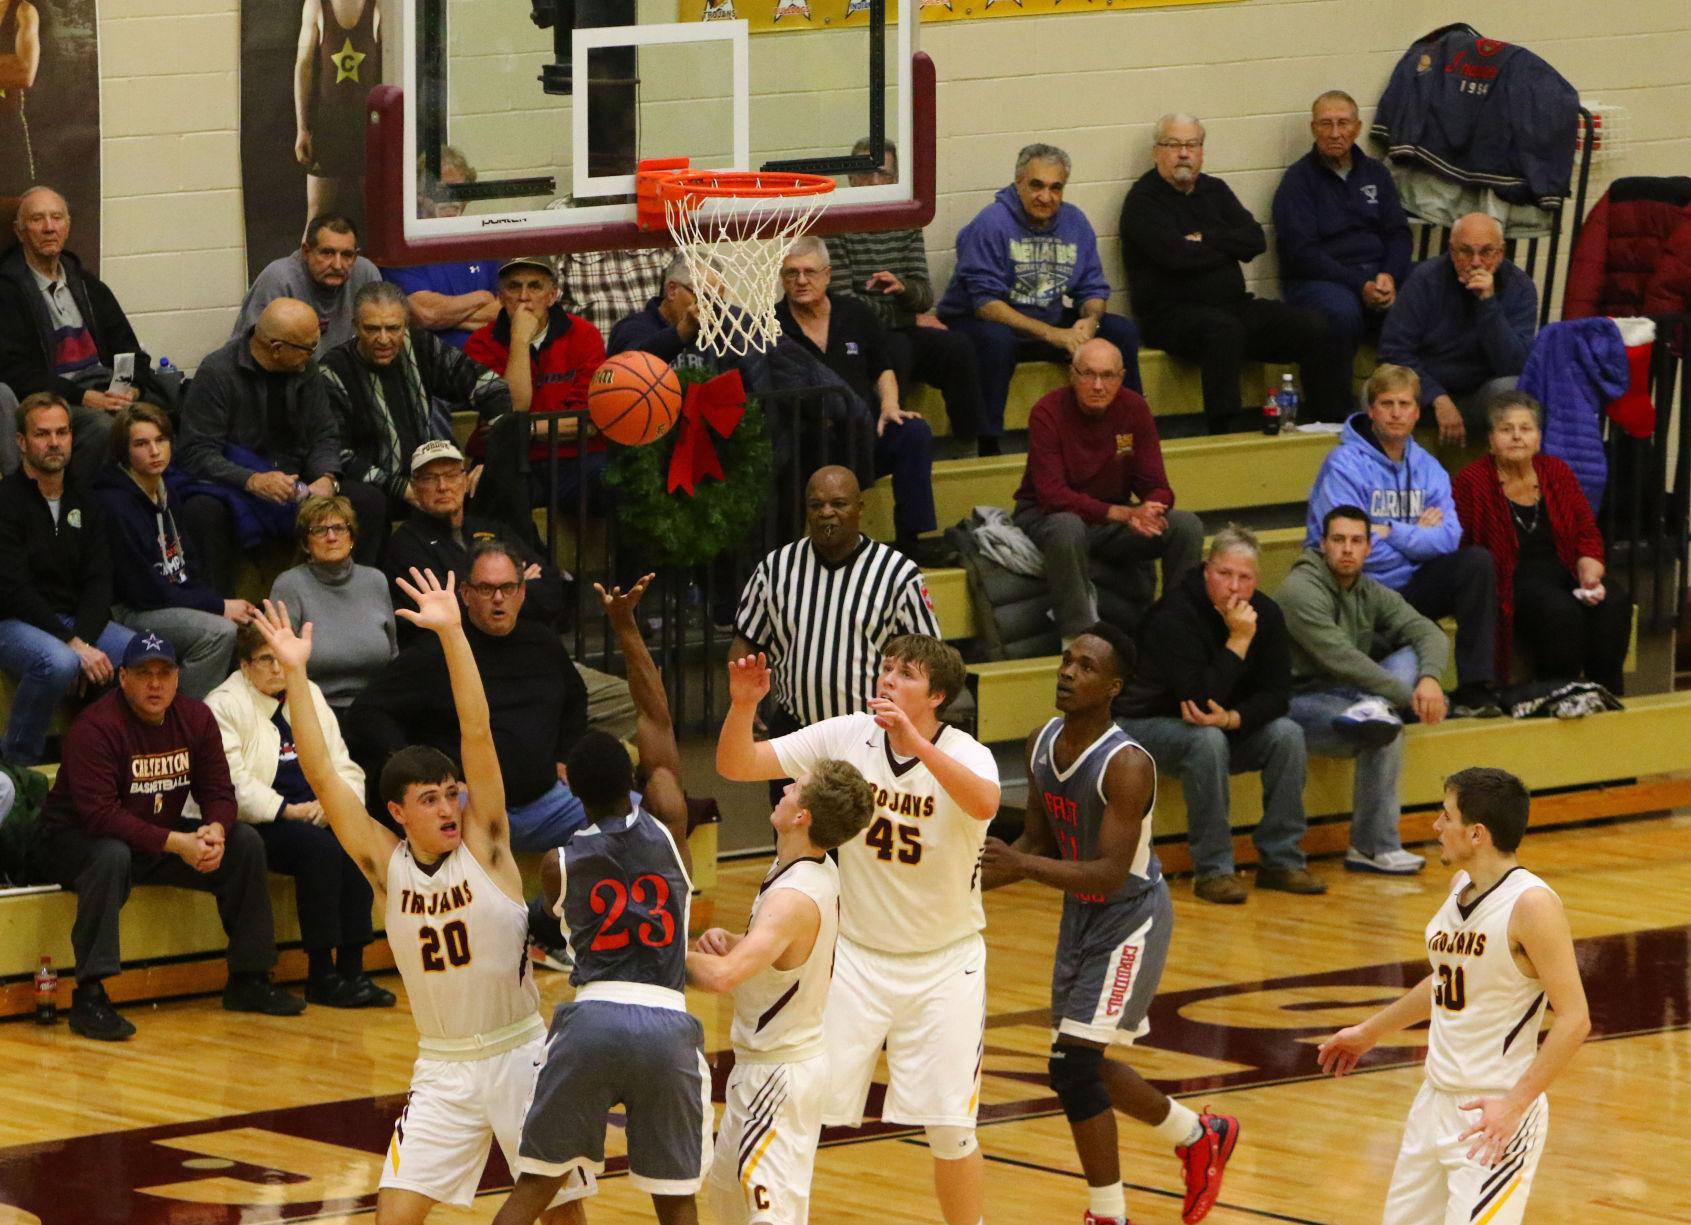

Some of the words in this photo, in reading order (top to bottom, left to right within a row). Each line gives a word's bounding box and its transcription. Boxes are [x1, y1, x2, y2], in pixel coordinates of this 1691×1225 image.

[341, 54, 355, 72] C
[129, 774, 191, 794] BASKETBALL
[865, 816, 922, 865] 45
[590, 874, 676, 952] 23
[419, 920, 472, 972] 20
[1106, 945, 1138, 1017] CARDINALS
[753, 1184, 770, 1210] C
